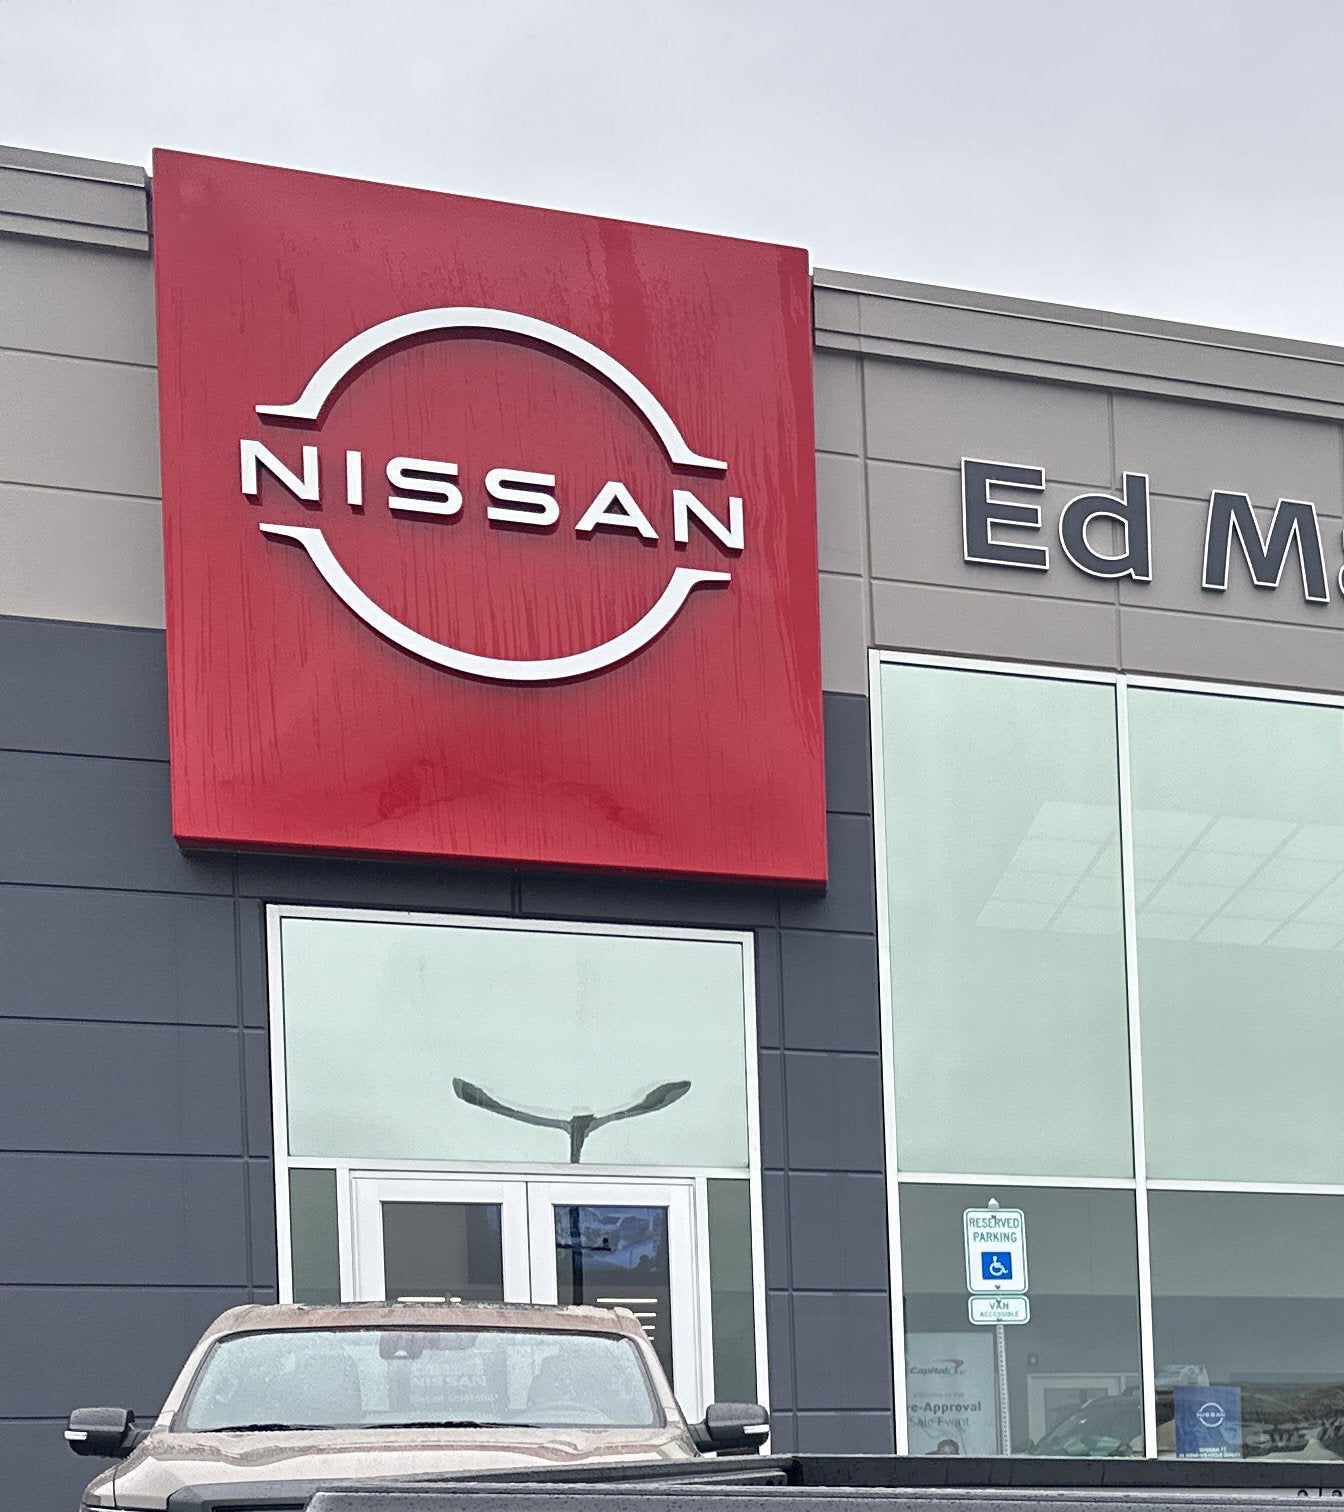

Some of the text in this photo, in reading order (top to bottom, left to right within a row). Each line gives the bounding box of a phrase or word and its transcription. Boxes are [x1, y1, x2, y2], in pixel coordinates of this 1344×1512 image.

[239, 438, 746, 551] NISSAN
[961, 457, 1153, 582] Ed
[968, 1217, 1020, 1229] RESERVED
[973, 1231, 1018, 1243] PARKING
[989, 1302, 1009, 1311] VAN
